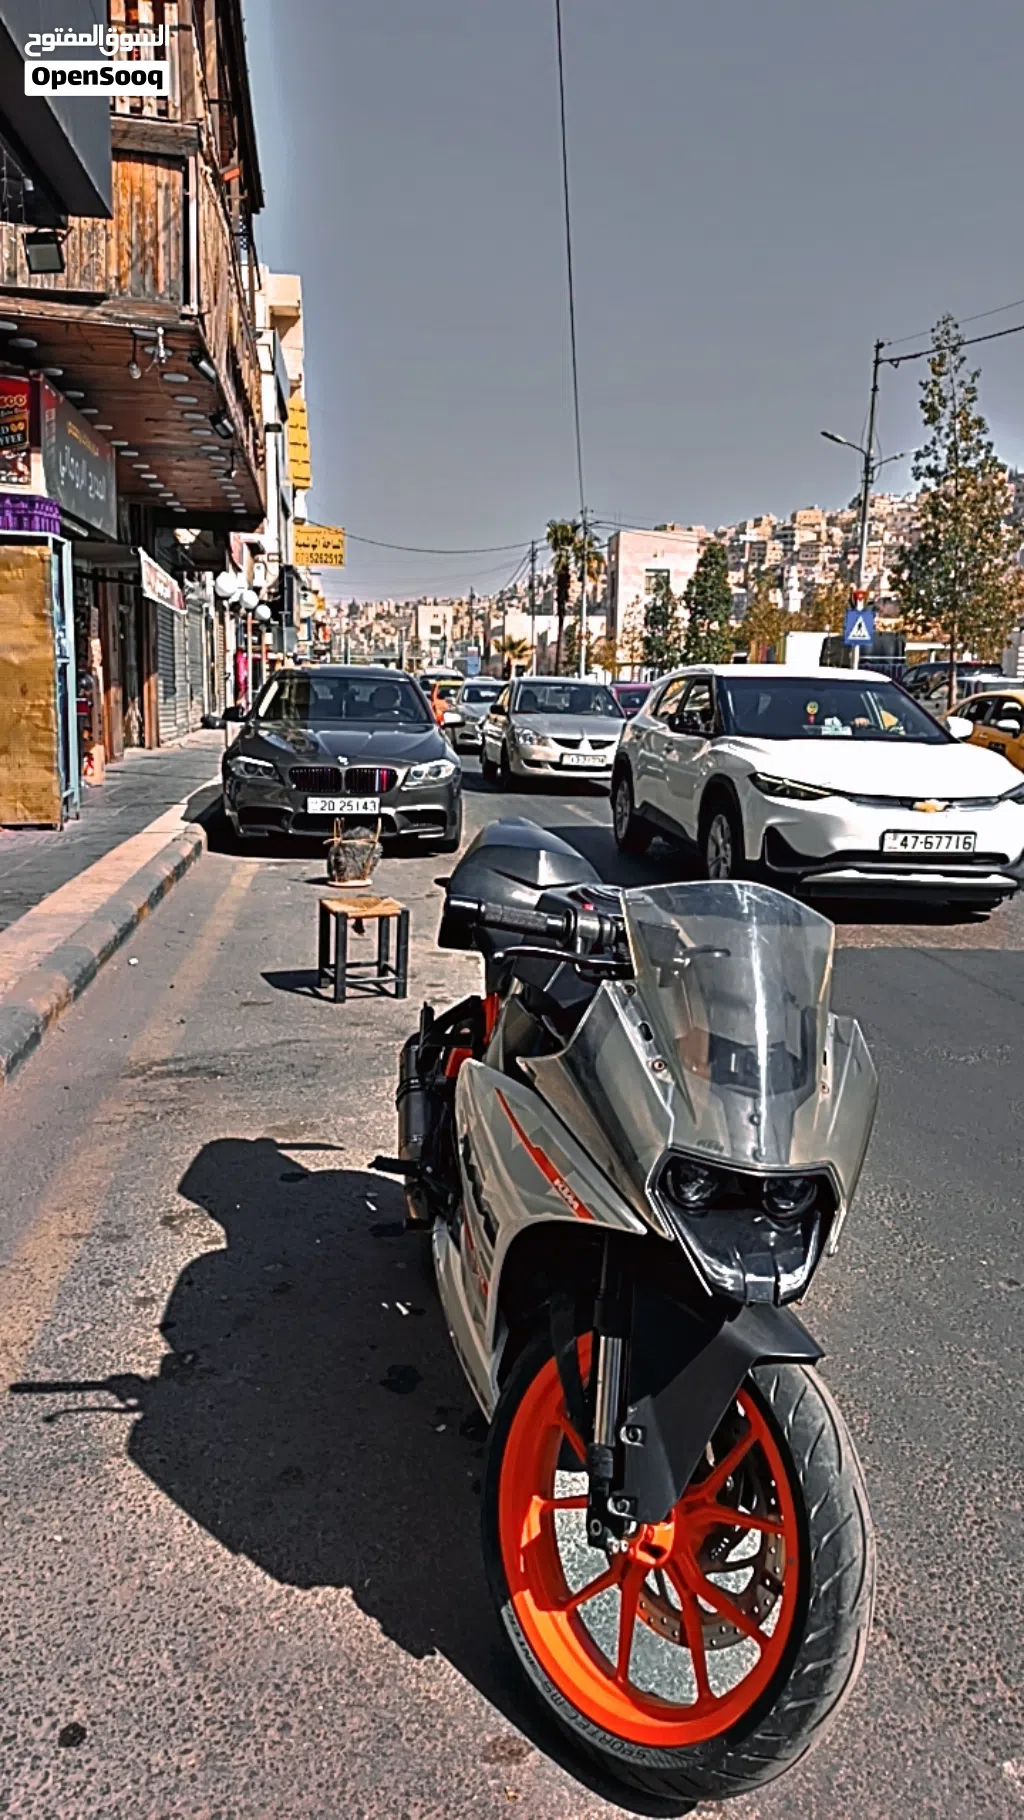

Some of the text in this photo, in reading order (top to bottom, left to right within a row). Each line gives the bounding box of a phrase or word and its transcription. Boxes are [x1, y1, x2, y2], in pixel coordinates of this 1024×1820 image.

[320, 800, 335, 811] 20
[900, 835, 972, 851] 47-67716
[563, 1705, 647, 1760] SPORTEC
